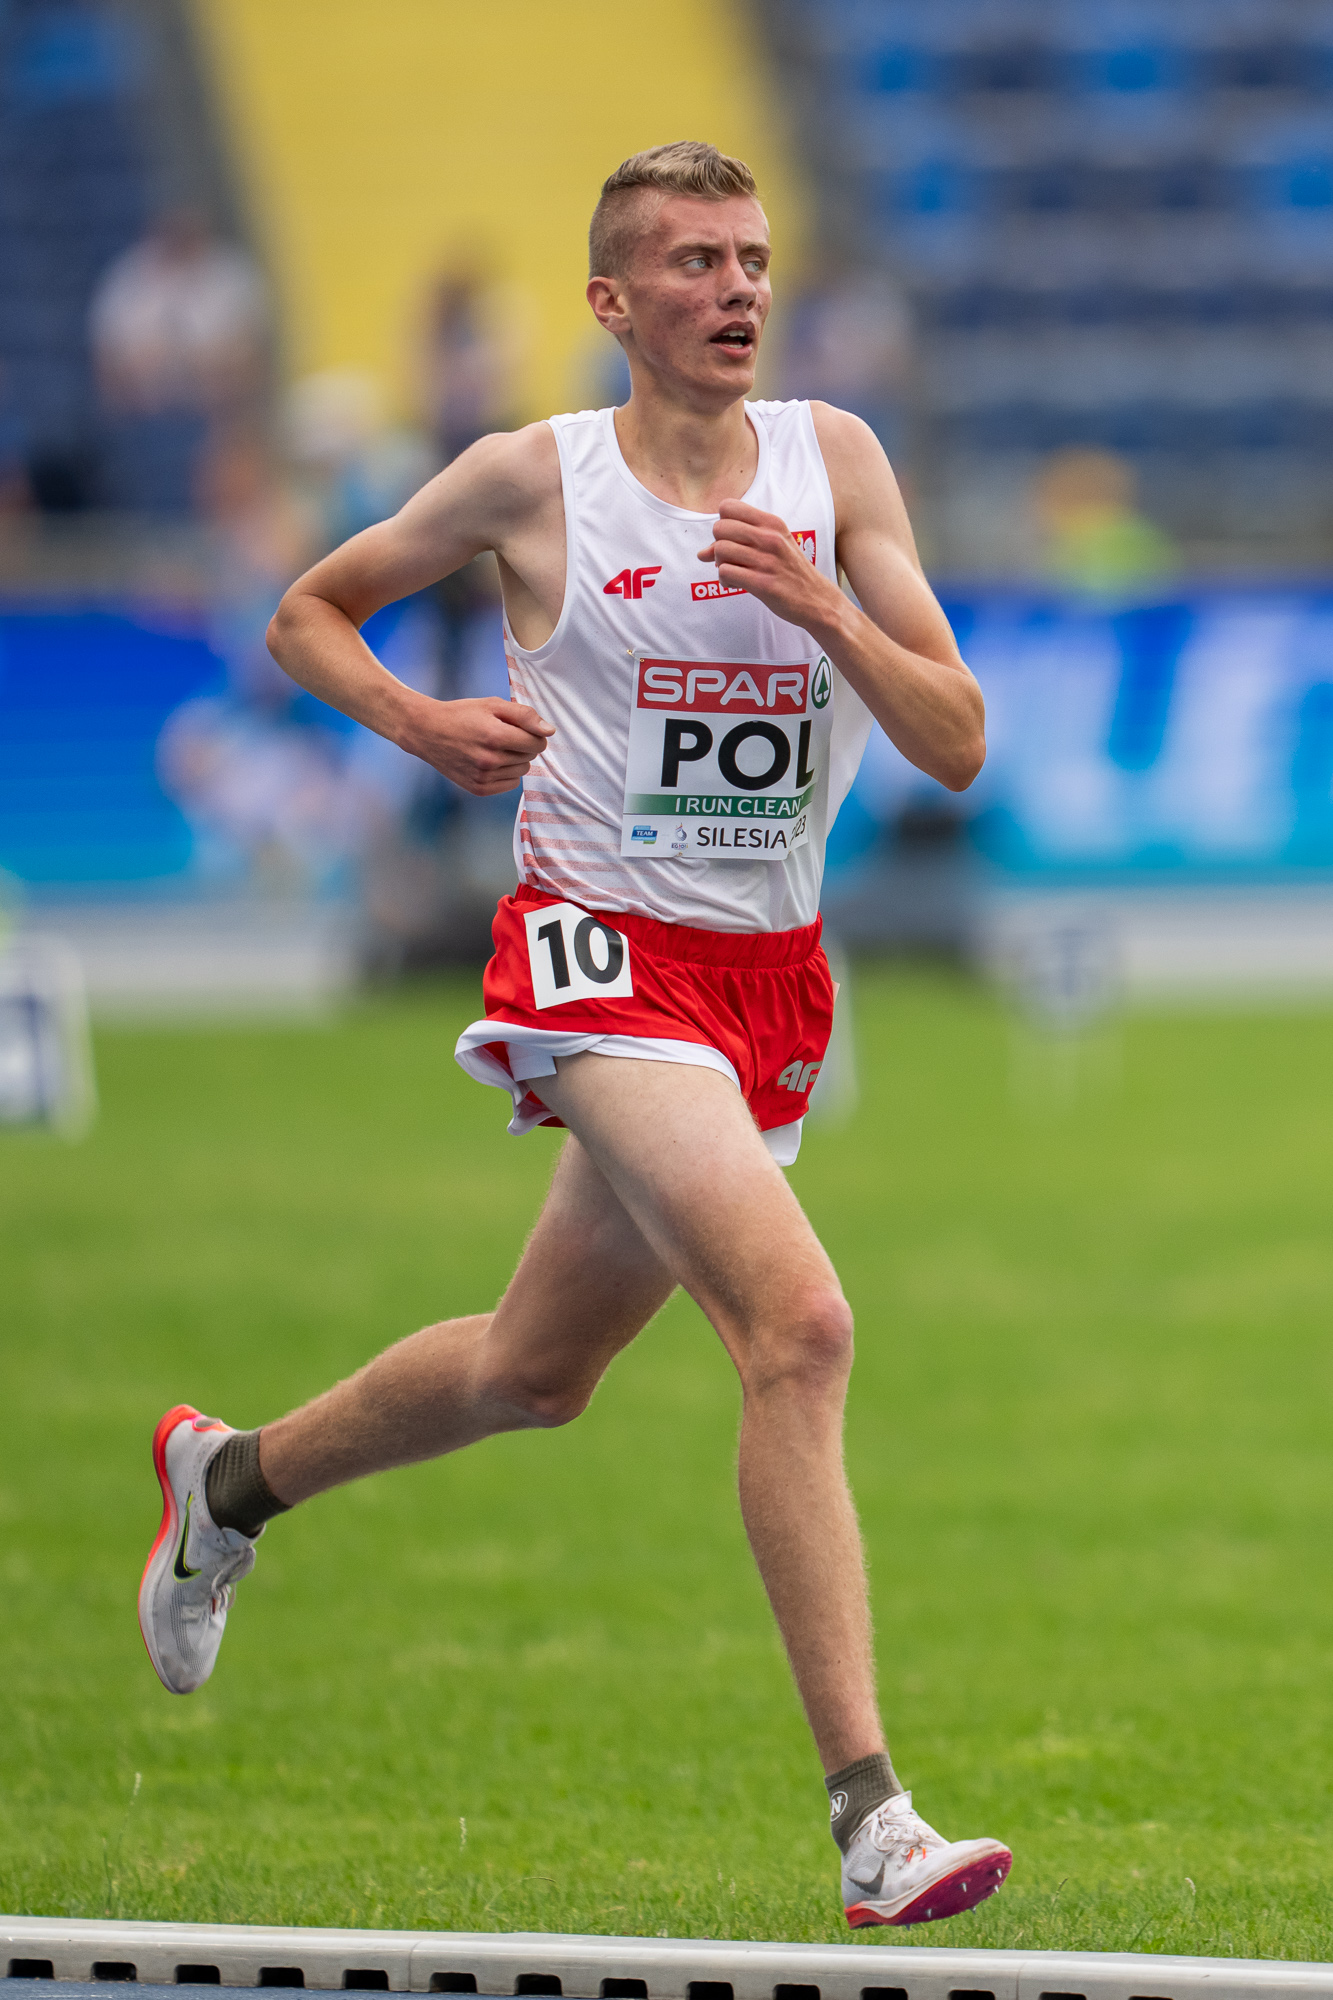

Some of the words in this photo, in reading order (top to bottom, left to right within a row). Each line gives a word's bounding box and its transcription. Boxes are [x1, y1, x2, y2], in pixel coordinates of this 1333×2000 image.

[603, 566, 663, 599] 4F
[694, 583, 743, 598] ORL
[643, 666, 805, 707] SPAR
[661, 718, 815, 791] POL
[675, 797, 681, 813] I
[686, 797, 733, 814] RUN
[737, 798, 801, 816] CLEAN
[697, 826, 788, 849] SILESIA
[537, 916, 625, 990] 10
[777, 1060, 824, 1093] 4F
